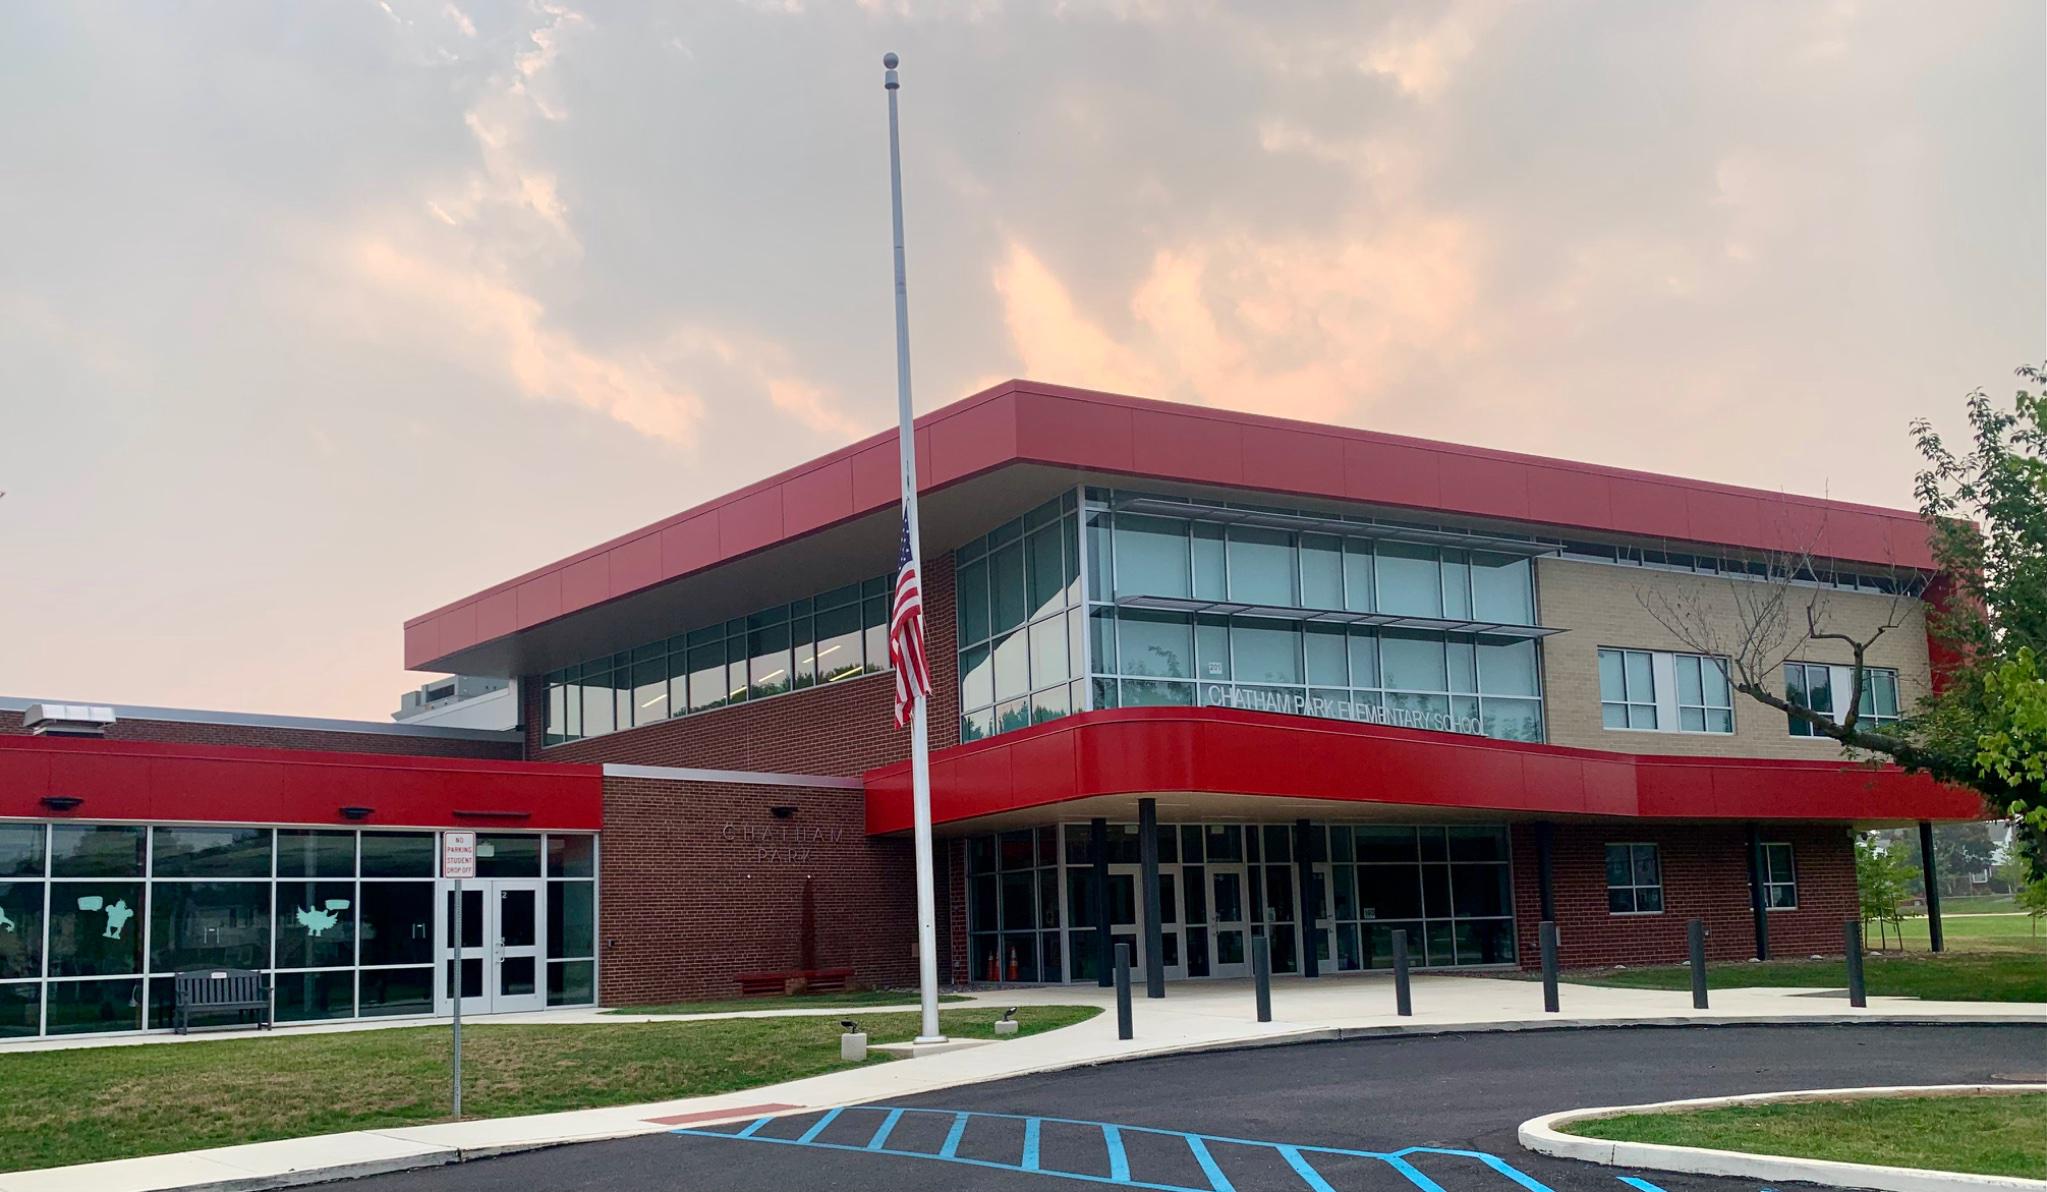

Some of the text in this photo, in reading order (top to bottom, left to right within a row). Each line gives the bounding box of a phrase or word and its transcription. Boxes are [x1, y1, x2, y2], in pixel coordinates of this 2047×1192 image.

[1208, 685, 1488, 736] CHATHAM PARK ELEMENTARY SCHOOL
[723, 824, 843, 842] CHATHAM
[758, 849, 810, 863] PARK
